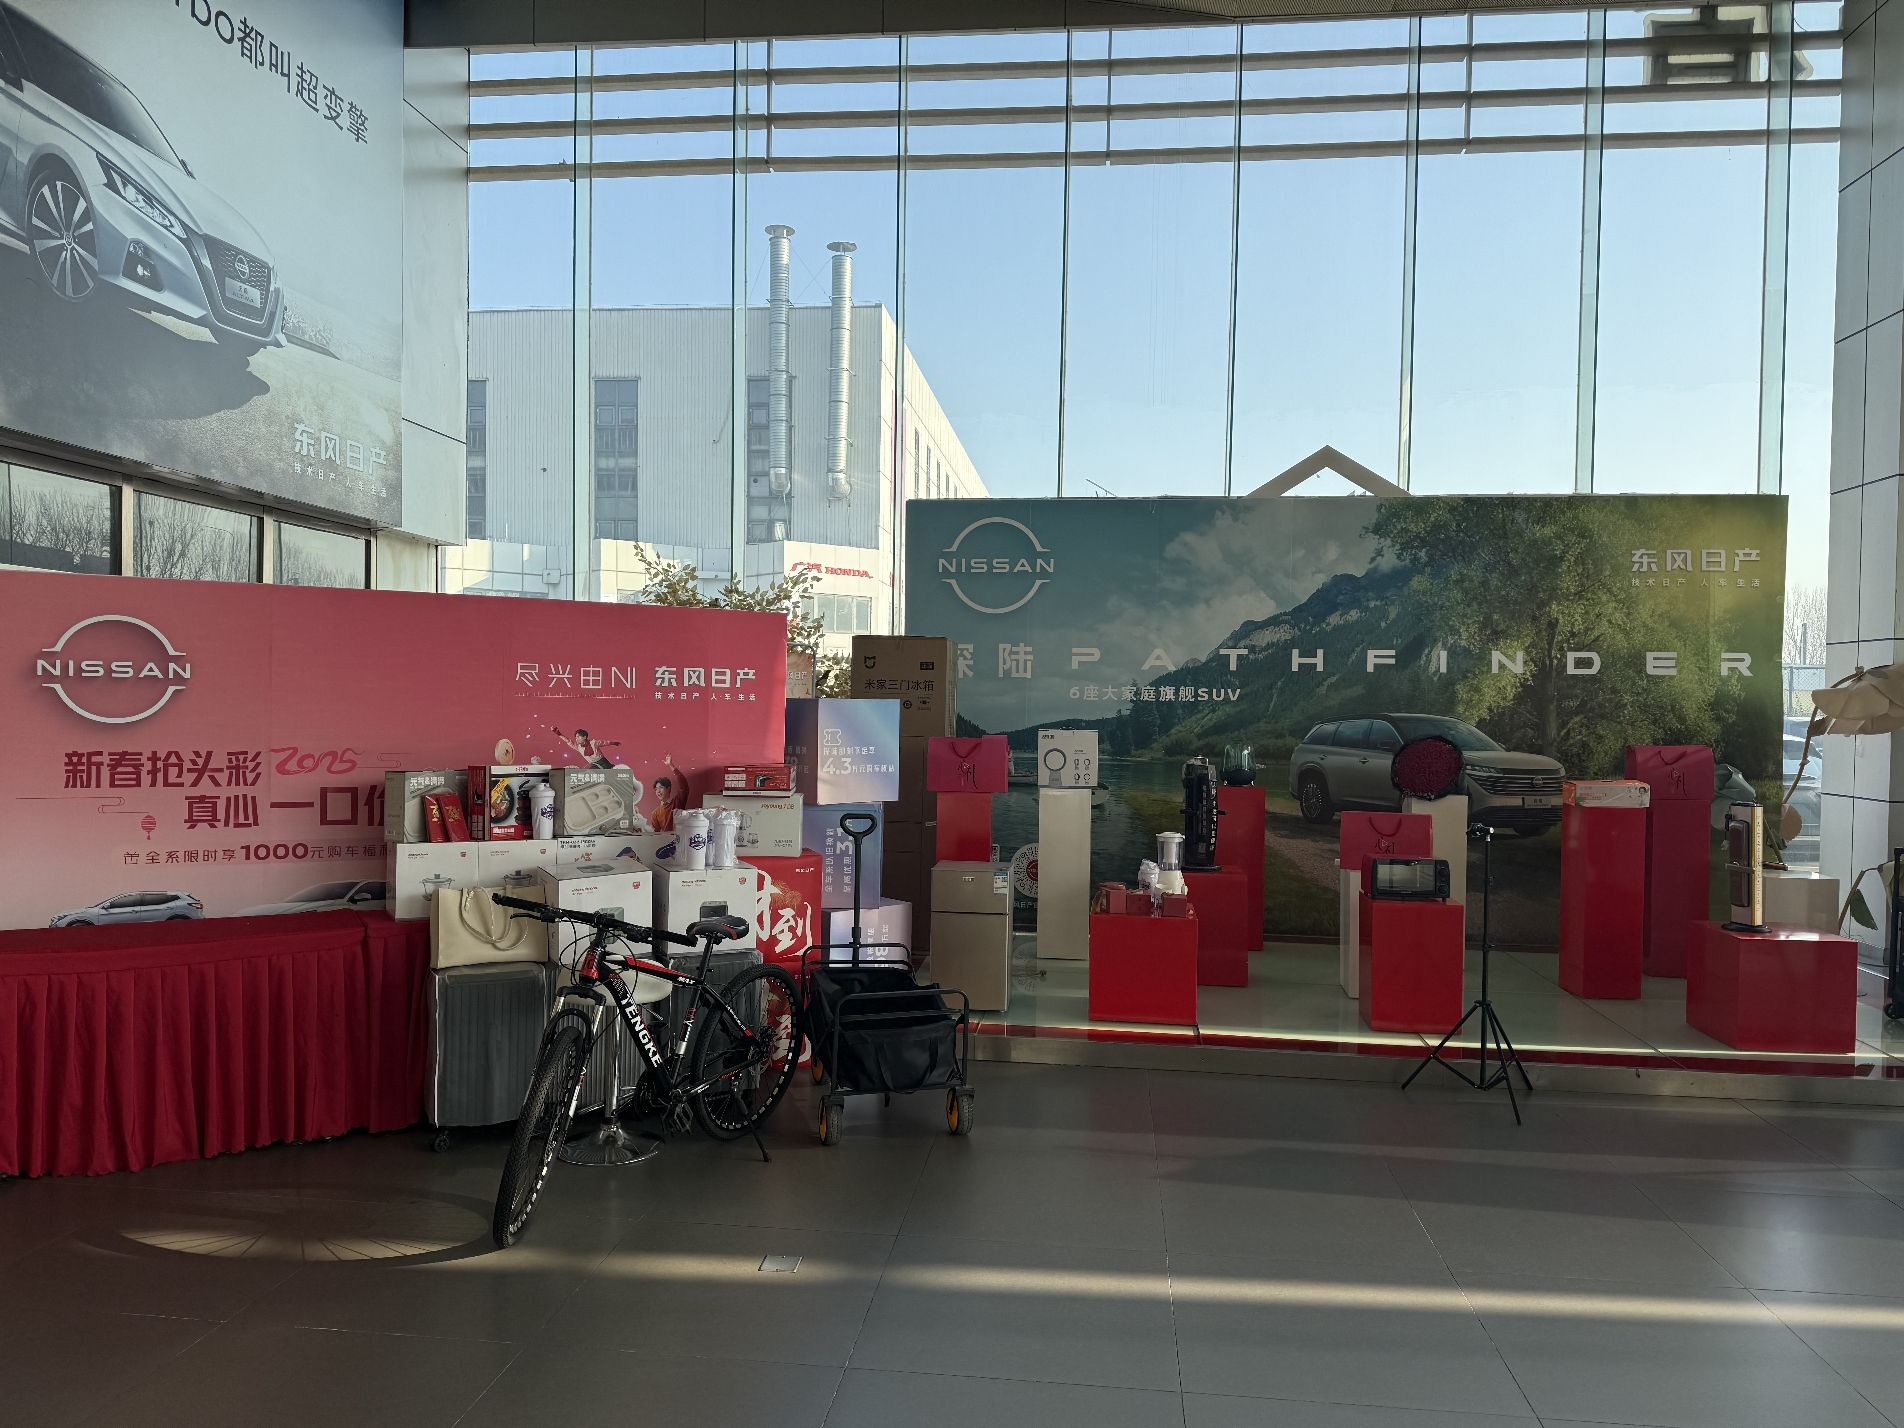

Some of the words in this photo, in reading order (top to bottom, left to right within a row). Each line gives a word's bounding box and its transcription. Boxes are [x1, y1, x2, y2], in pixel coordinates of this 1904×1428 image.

[294, 422, 387, 475] 东风日产
[938, 558, 1054, 573] NISSAN
[1631, 547, 1761, 572] 东风日产
[825, 566, 869, 578] HONDA
[1631, 577, 1687, 588] 技术日产
[36, 659, 191, 679] NISSAN
[1070, 647, 1755, 677] PATHFINDER
[515, 662, 636, 689] 尽兴由NI
[654, 665, 757, 688] 东风日产
[864, 678, 935, 692] 米家三门冰箱
[654, 691, 700, 700] 技术日产
[1068, 685, 1241, 702] 6座大家庭旗舰SUV
[63, 750, 263, 789] 新春抢头彩
[620, 986, 663, 1068] TENGKE
